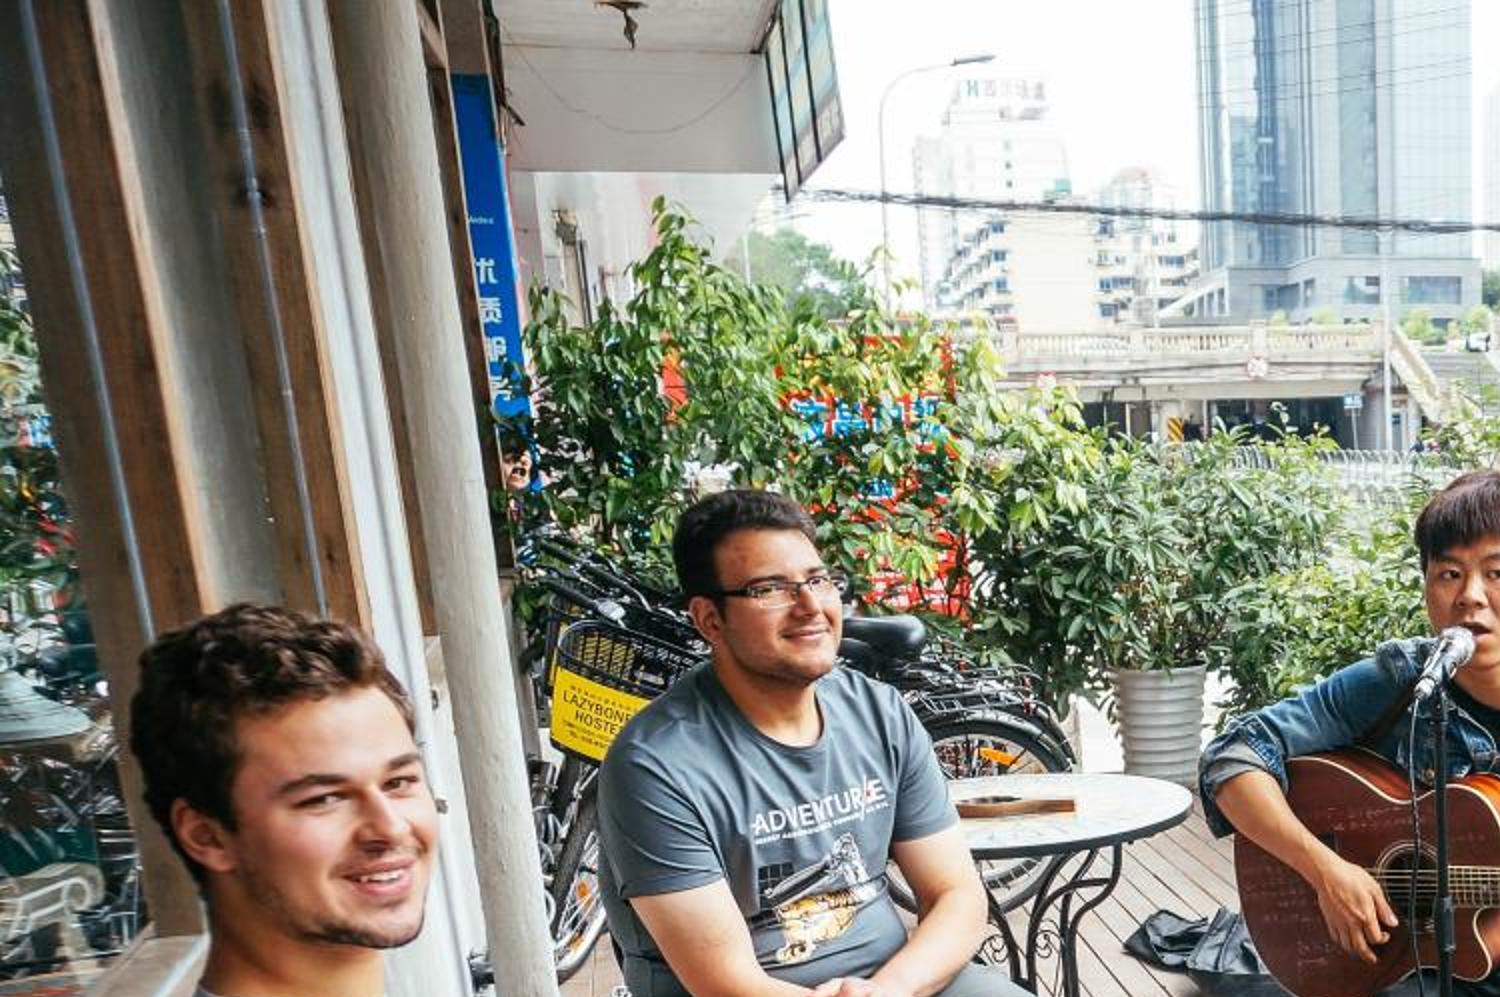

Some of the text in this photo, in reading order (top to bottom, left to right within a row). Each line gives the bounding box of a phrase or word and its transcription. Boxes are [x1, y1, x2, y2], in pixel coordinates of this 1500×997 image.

[563, 690, 633, 723] LAZYBONE
[575, 710, 623, 735] HOSTE
[752, 778, 887, 836] ADVENTURE
